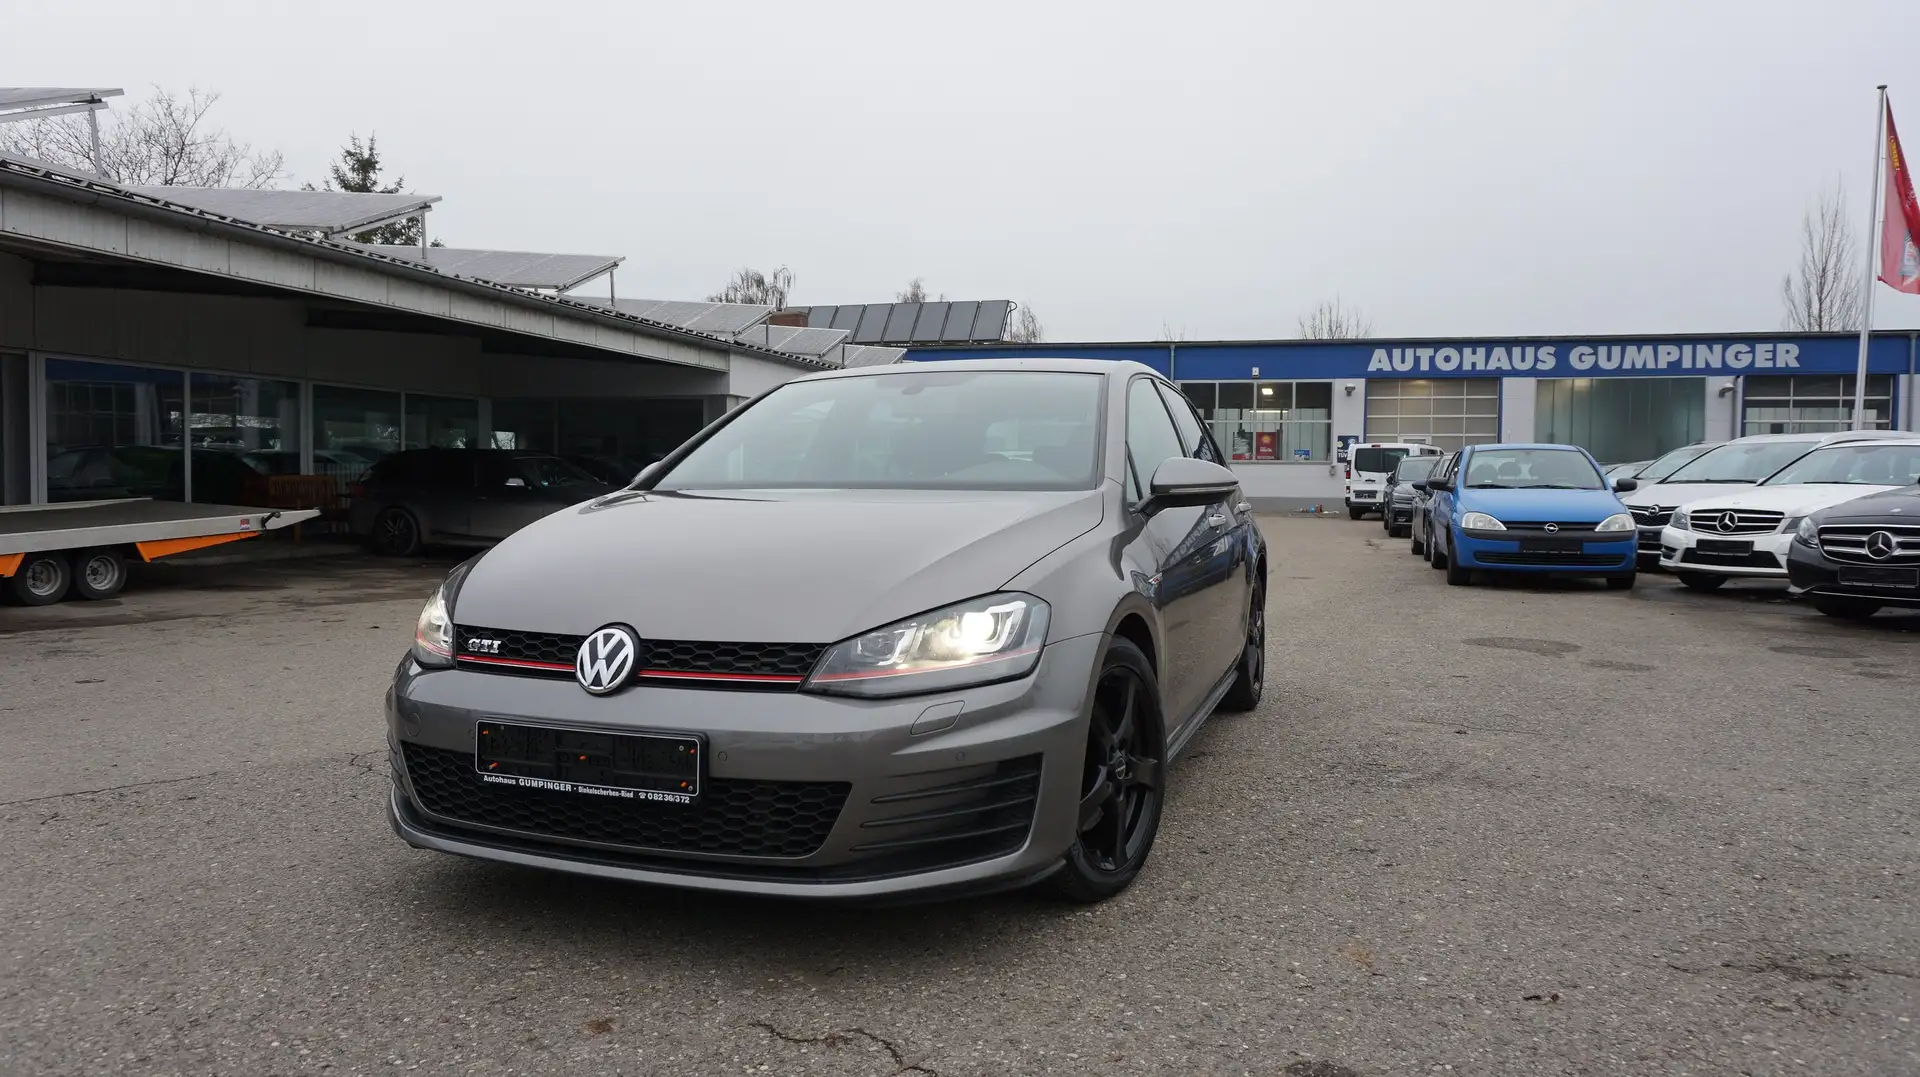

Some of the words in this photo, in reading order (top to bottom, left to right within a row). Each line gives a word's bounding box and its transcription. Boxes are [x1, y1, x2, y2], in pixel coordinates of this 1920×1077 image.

[1367, 346, 1556, 372] AUTOHAUS
[1569, 343, 1800, 370] GUMPINGER
[468, 638, 502, 654] GTI
[483, 775, 516, 785] Autohaus
[518, 778, 572, 792] GUMPINGER
[647, 792, 690, 804] 08236/372
